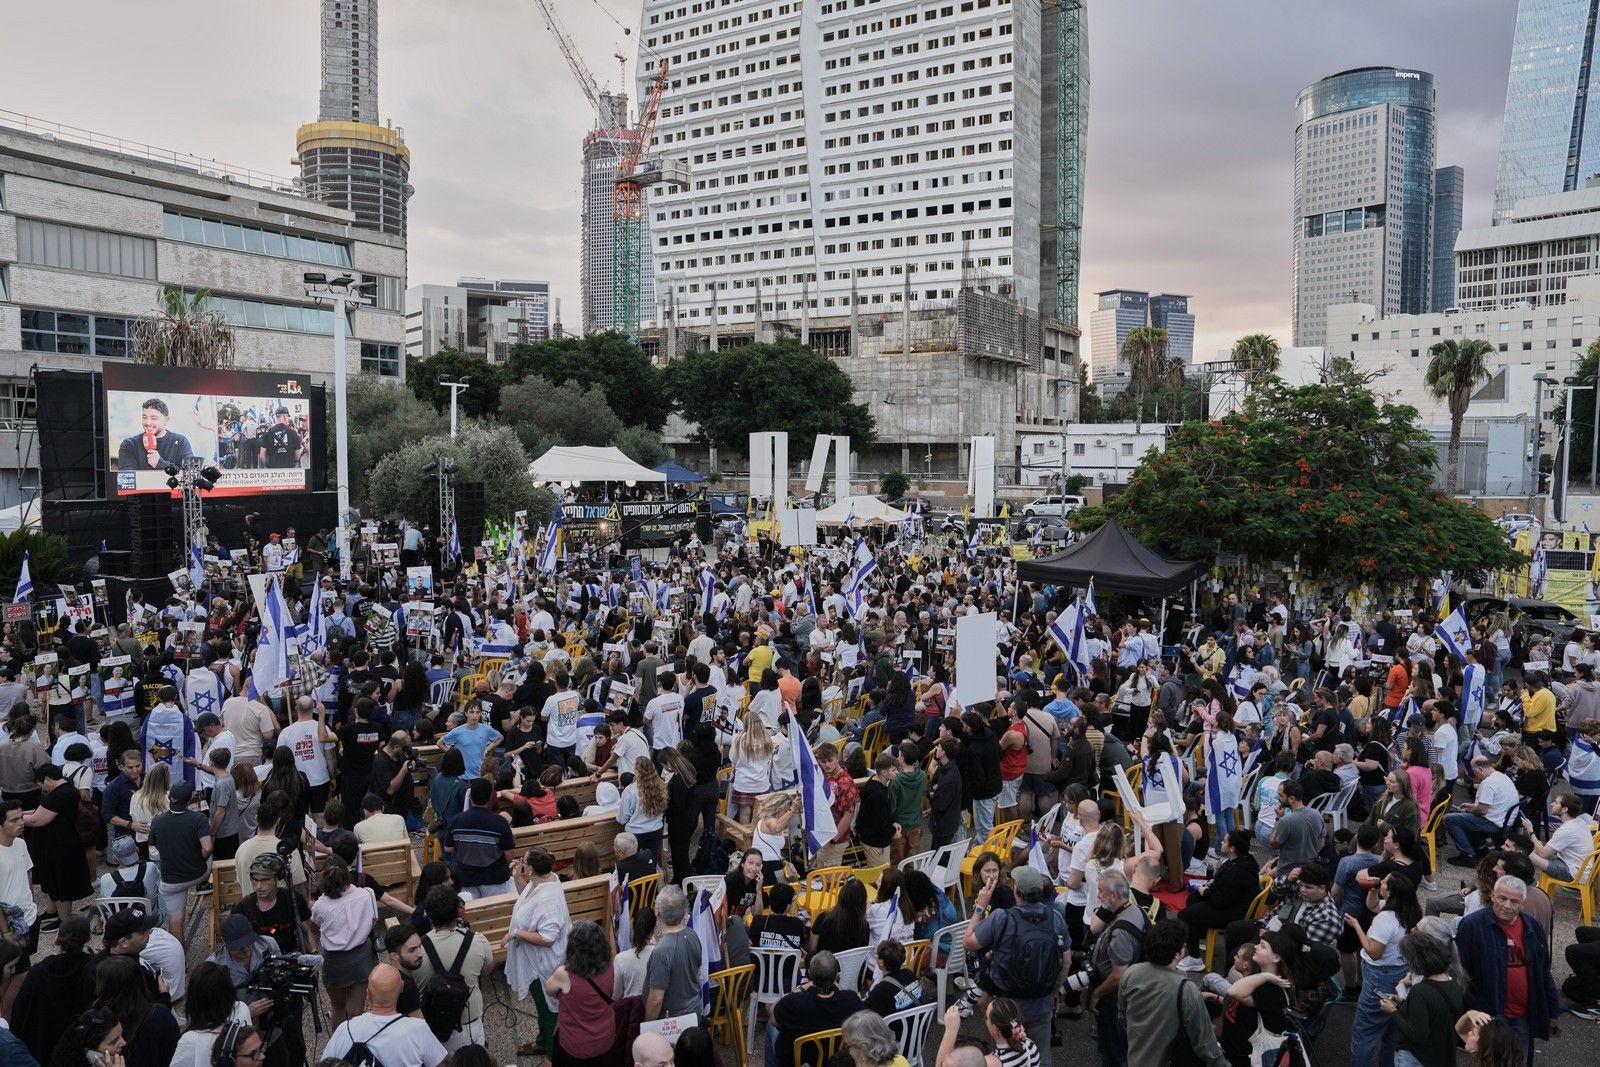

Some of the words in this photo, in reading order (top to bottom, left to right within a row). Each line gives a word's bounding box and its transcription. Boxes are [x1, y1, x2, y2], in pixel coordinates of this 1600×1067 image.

[561, 505, 584, 518] מתייצ
[623, 504, 651, 516] החטופים
[651, 504, 661, 515] את
[295, 740, 313, 750] כולם
